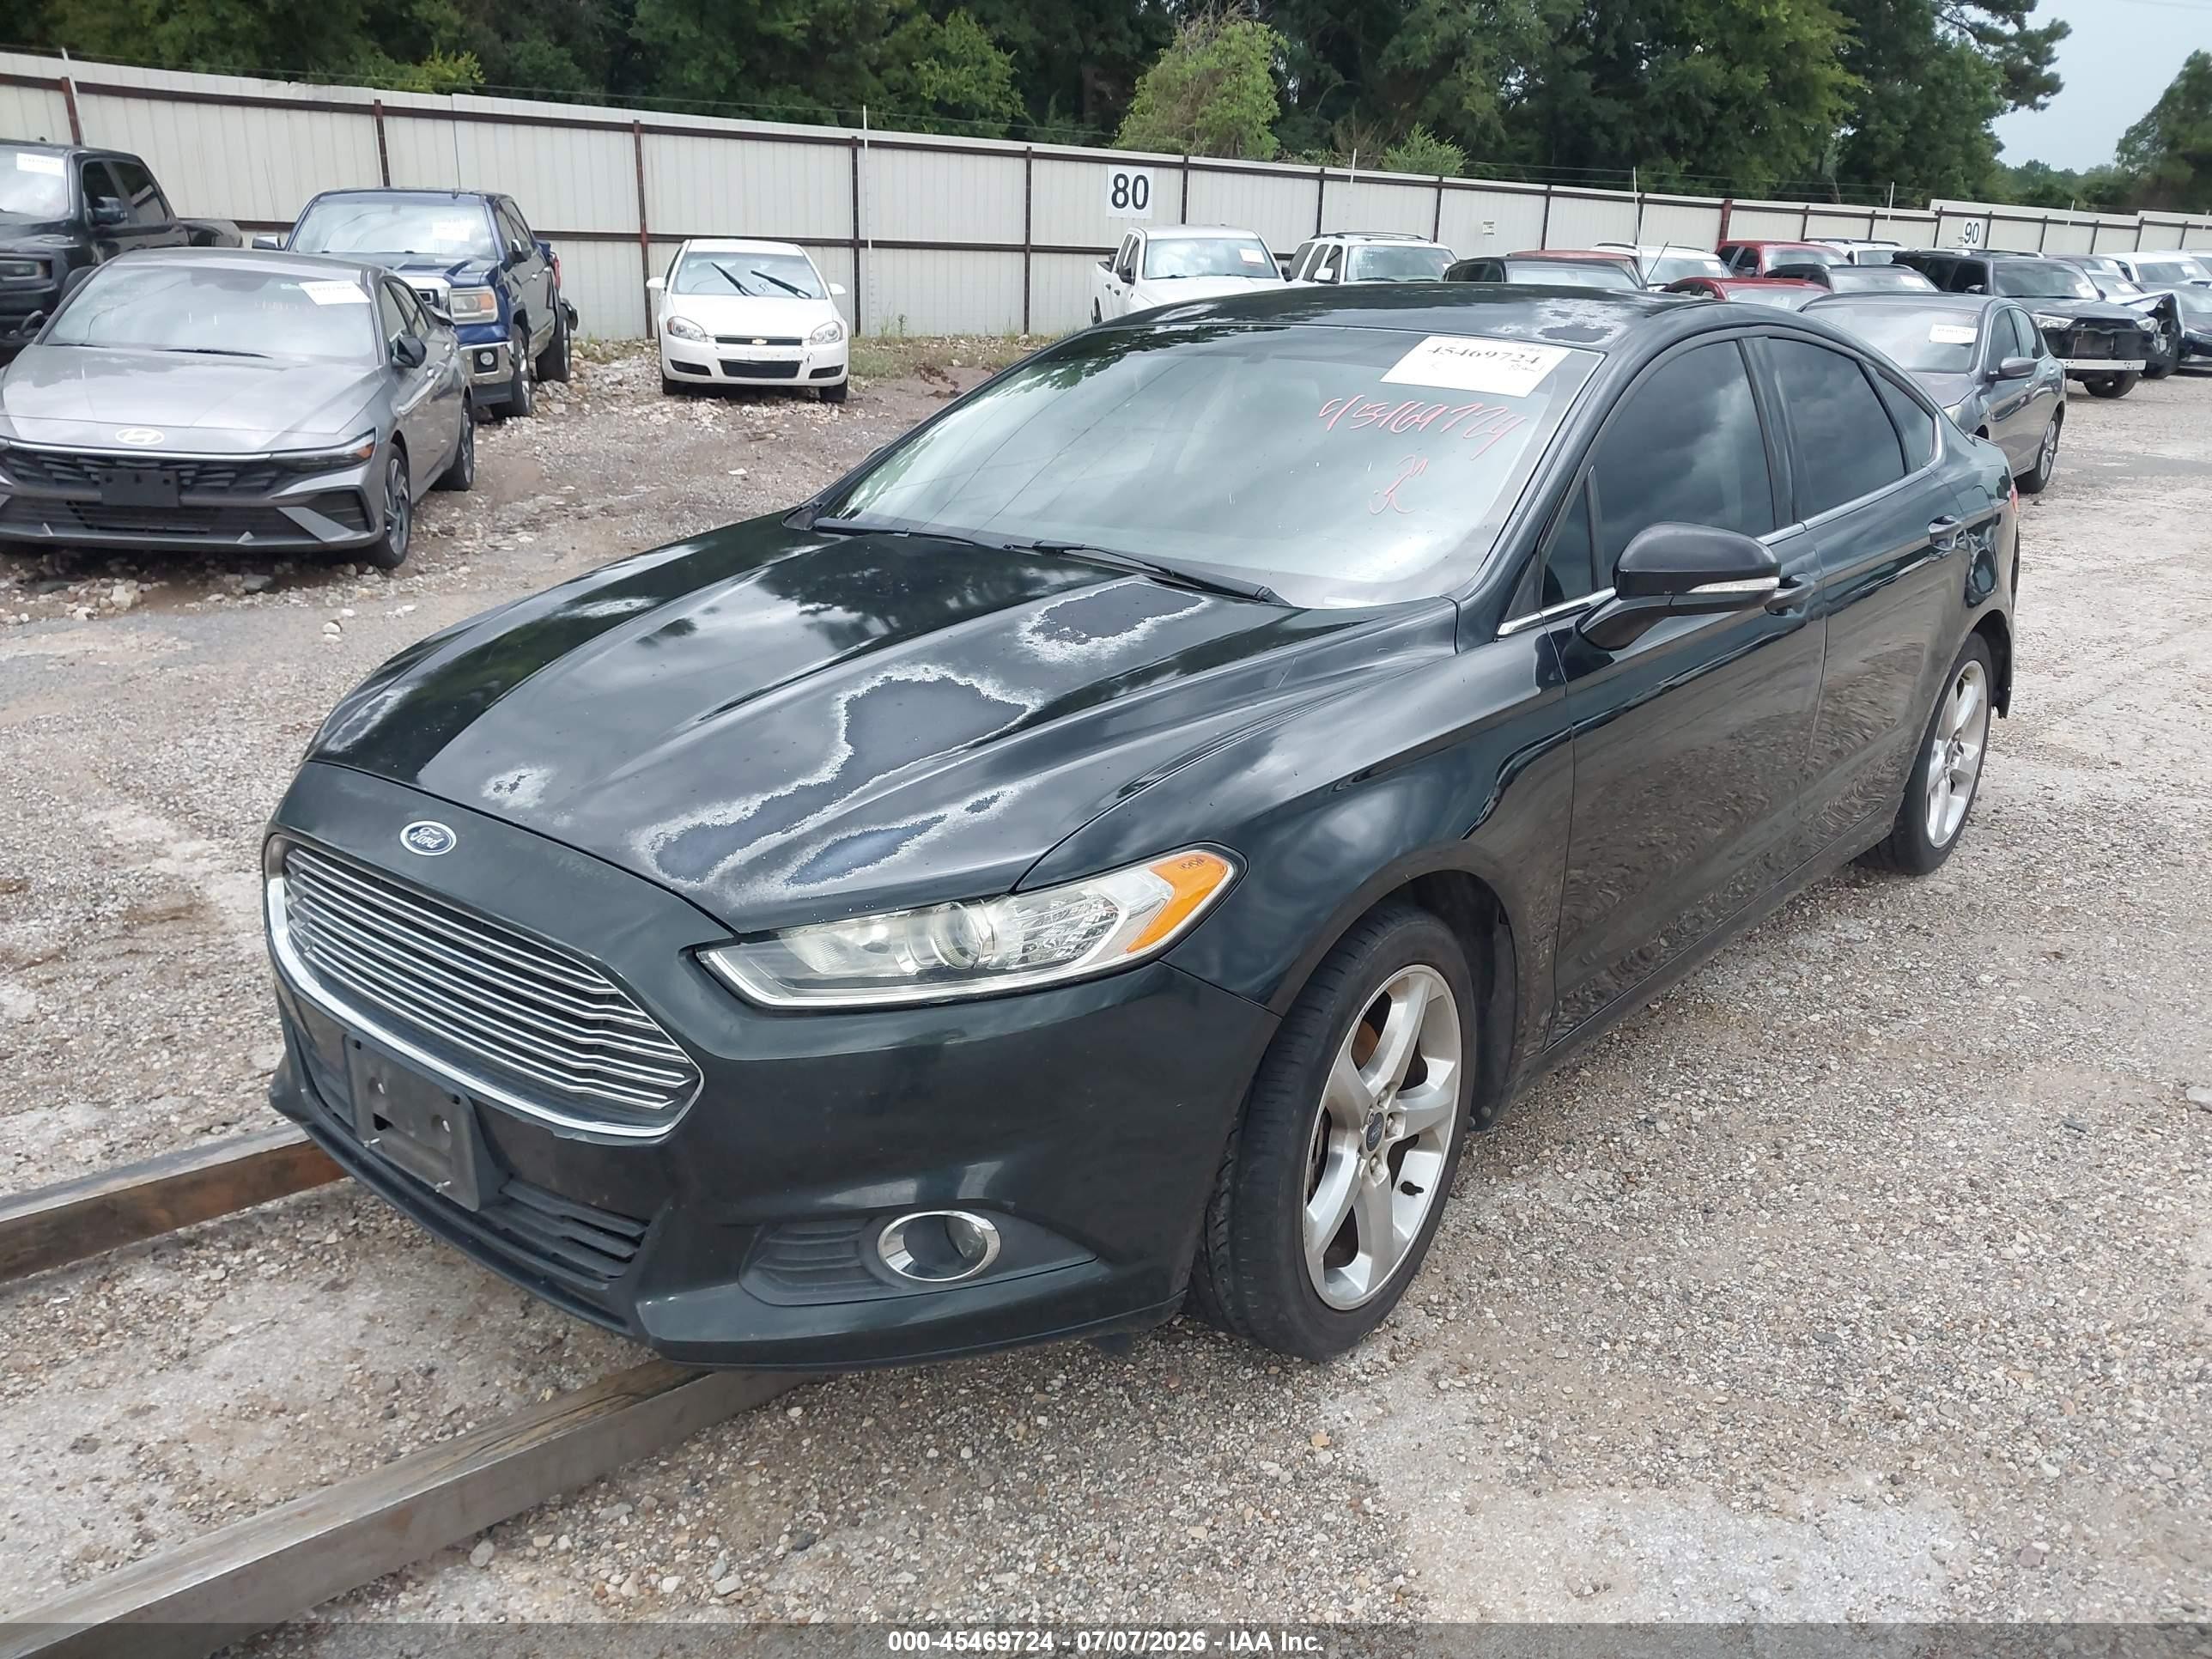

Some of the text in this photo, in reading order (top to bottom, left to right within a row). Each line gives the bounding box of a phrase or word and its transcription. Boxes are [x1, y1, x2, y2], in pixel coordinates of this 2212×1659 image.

[1111, 173, 1149, 210] 80
[1963, 222, 1980, 244] 90
[1426, 345, 1541, 365] 45469724
[410, 826, 445, 849] Ford
